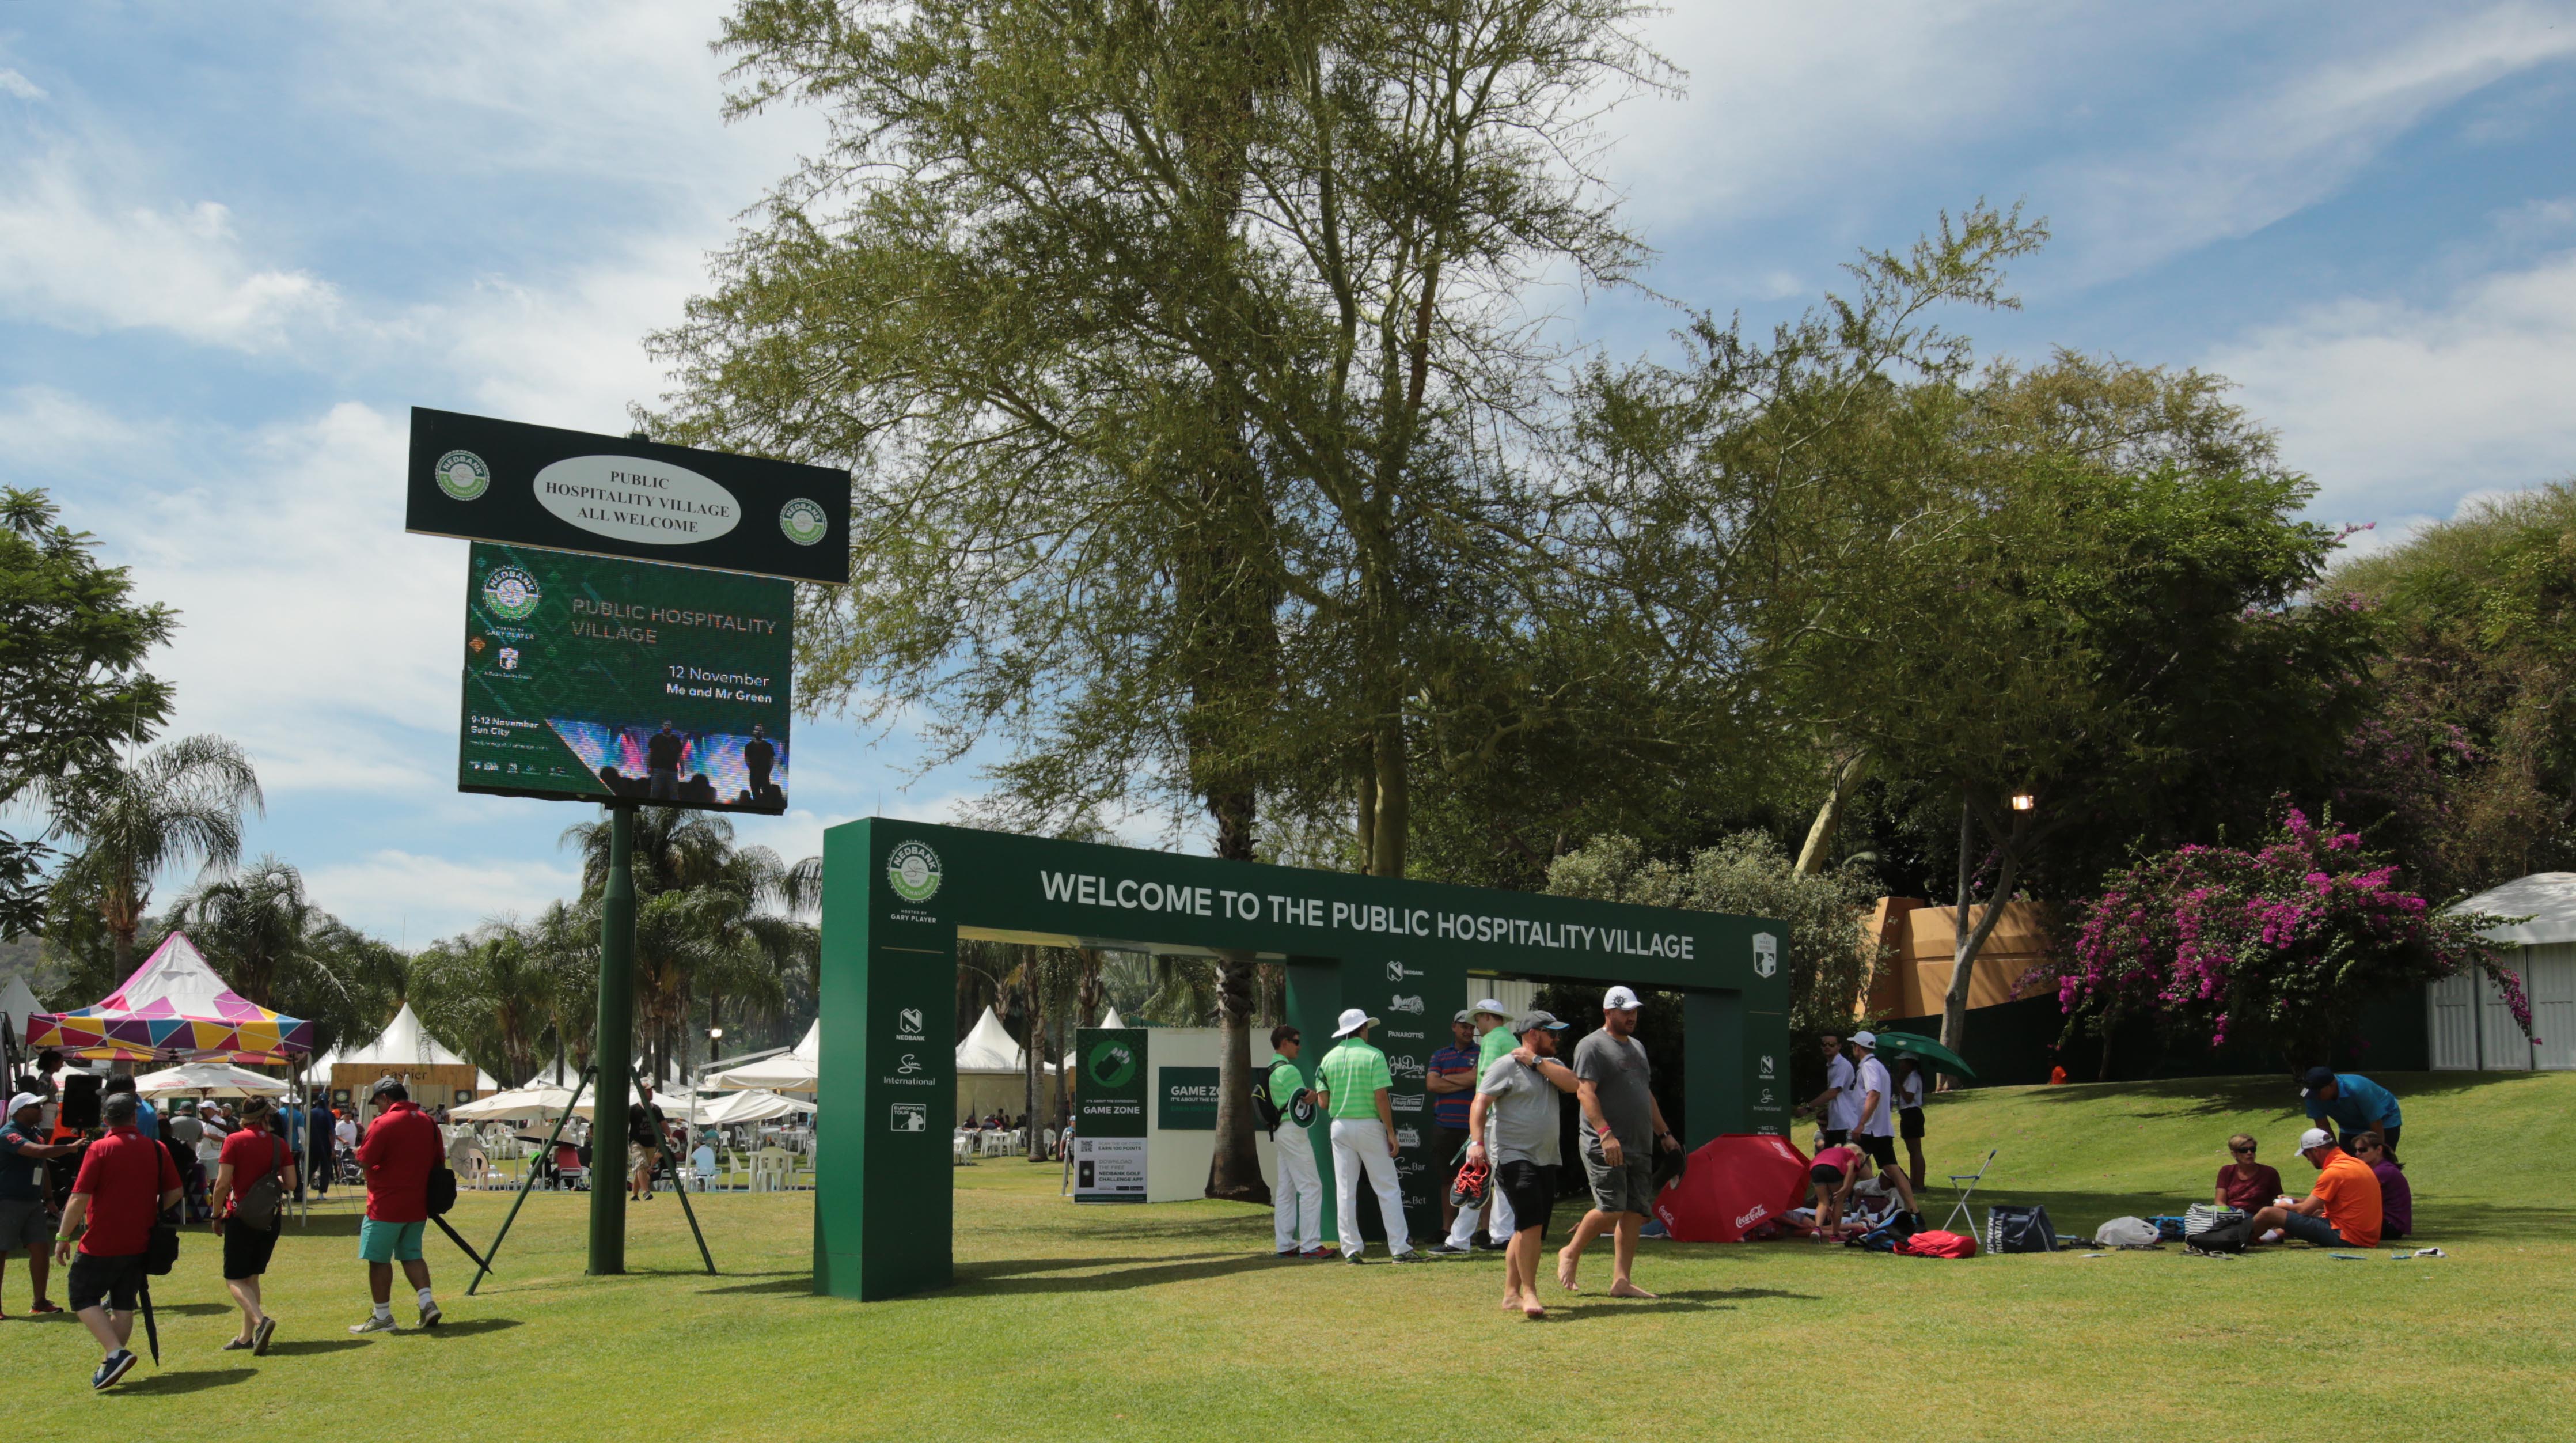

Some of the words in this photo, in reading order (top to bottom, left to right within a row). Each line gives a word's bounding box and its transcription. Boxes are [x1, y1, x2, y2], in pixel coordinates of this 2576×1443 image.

[443, 456, 483, 475] NEDBANK
[610, 471, 669, 490] PUBLIC
[545, 482, 655, 507] HOSPITALITY
[659, 497, 730, 517] VILLAGE
[577, 507, 610, 521] ALL
[613, 511, 699, 533] WELCOME
[786, 503, 821, 521] NEDBANK
[572, 598, 646, 620] PUBLIC
[651, 607, 777, 634] HOSPITALITY
[571, 621, 658, 644] VILLAGE
[669, 665, 685, 679] 12
[689, 667, 770, 687] November
[666, 683, 686, 696] Me
[691, 687, 712, 698] and
[715, 688, 733, 700] Mr
[735, 690, 772, 703] Green
[471, 715, 490, 725] 9-12
[492, 717, 540, 728] November
[471, 725, 488, 734] Sun
[490, 727, 510, 737] City
[893, 846, 936, 870] NEDBANK
[894, 873, 905, 891] GOLF
[905, 877, 935, 896] CHALLENGE
[911, 915, 937, 923] PLAYER
[1040, 870, 1212, 916] WELCOME
[1219, 890, 1261, 921] TO
[1267, 895, 1324, 927] THE
[1332, 902, 1430, 936] PUBLIC
[1437, 912, 1596, 950] HOSPITALITY
[1599, 928, 1694, 960] VILLAGE
[883, 1076, 935, 1085] International
[1170, 1086, 1207, 1096] GAME
[1083, 1106, 1112, 1114] GAME
[1113, 1106, 1140, 1114] ZONE
[1412, 1162, 1426, 1171] Bar
[1412, 1196, 1427, 1205] Bet
[1735, 1203, 1768, 1228] Coca-Cola
